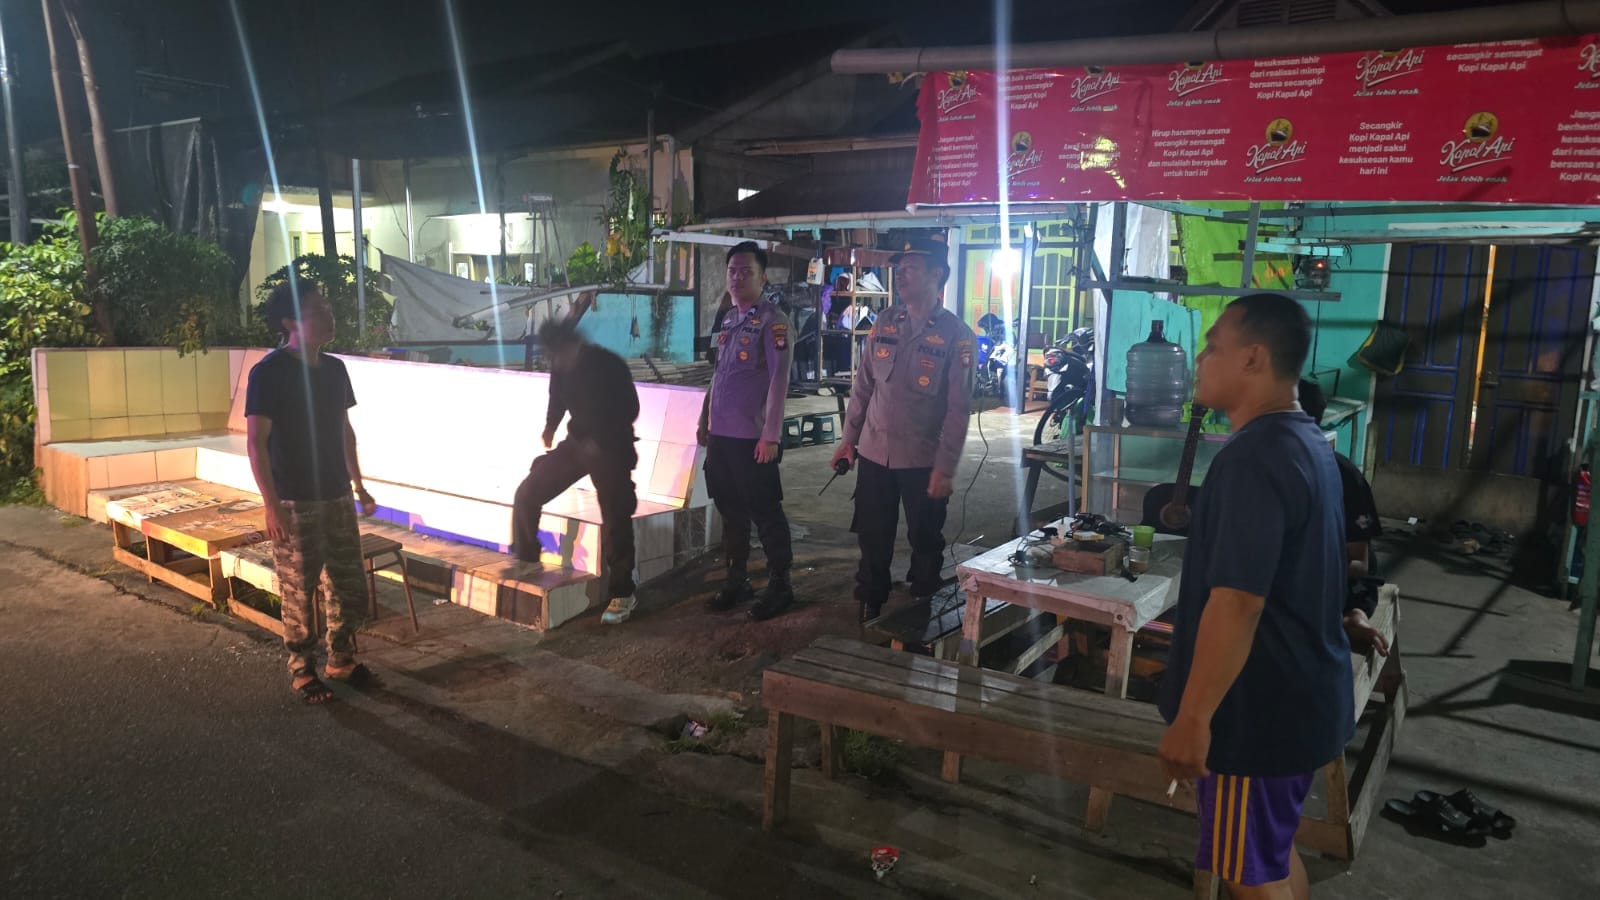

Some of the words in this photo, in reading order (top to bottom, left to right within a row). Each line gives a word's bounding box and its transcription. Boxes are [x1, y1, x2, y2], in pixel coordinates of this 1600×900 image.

[1447, 50, 1492, 61] secangkir
[1494, 48, 1543, 59] semangat
[1301, 56, 1320, 64] lahir
[1356, 54, 1398, 81] Kapal
[1396, 50, 1425, 70] Api
[1458, 63, 1479, 73] Kopi
[1480, 62, 1508, 72] Kapal
[1509, 61, 1526, 72] Api
[1250, 70, 1265, 78] dari
[1266, 68, 1299, 77] realisasi
[1300, 66, 1325, 75] mimpi
[1168, 67, 1202, 93] Kapal
[1200, 64, 1224, 83] Api
[1284, 77, 1324, 87] secangkir
[1071, 76, 1102, 99] Kapal
[1100, 72, 1120, 90] Api
[1257, 91, 1274, 100] Kopi
[1275, 90, 1298, 99] Kapal
[1299, 89, 1313, 99] Api
[1360, 121, 1403, 130] Secangkir
[1152, 129, 1170, 137] Hirup
[1171, 128, 1206, 137] harumnya
[1207, 127, 1231, 135] aroma
[1349, 133, 1368, 142] Kopi
[1369, 133, 1394, 142] Kapal
[1395, 132, 1410, 142] Api
[1154, 140, 1188, 148] secangkir
[1190, 138, 1225, 147] semangat
[1163, 149, 1179, 158] Kopi
[1180, 148, 1200, 157] Kapal
[1201, 148, 1214, 157] Api
[1245, 143, 1283, 168] Kapal
[1281, 140, 1308, 160] Api
[1349, 144, 1382, 154] menjadi
[1384, 144, 1407, 152] saksi
[1440, 139, 1486, 167] Kapal
[1483, 136, 1516, 158] Api
[1192, 159, 1227, 168] bersyukur
[1339, 155, 1388, 164] kesuksesan
[1389, 155, 1414, 163] kamu
[1184, 169, 1199, 177] hari
[1360, 167, 1376, 175] hari
[1377, 166, 1389, 175] ini
[1560, 172, 1582, 182] Kopi
